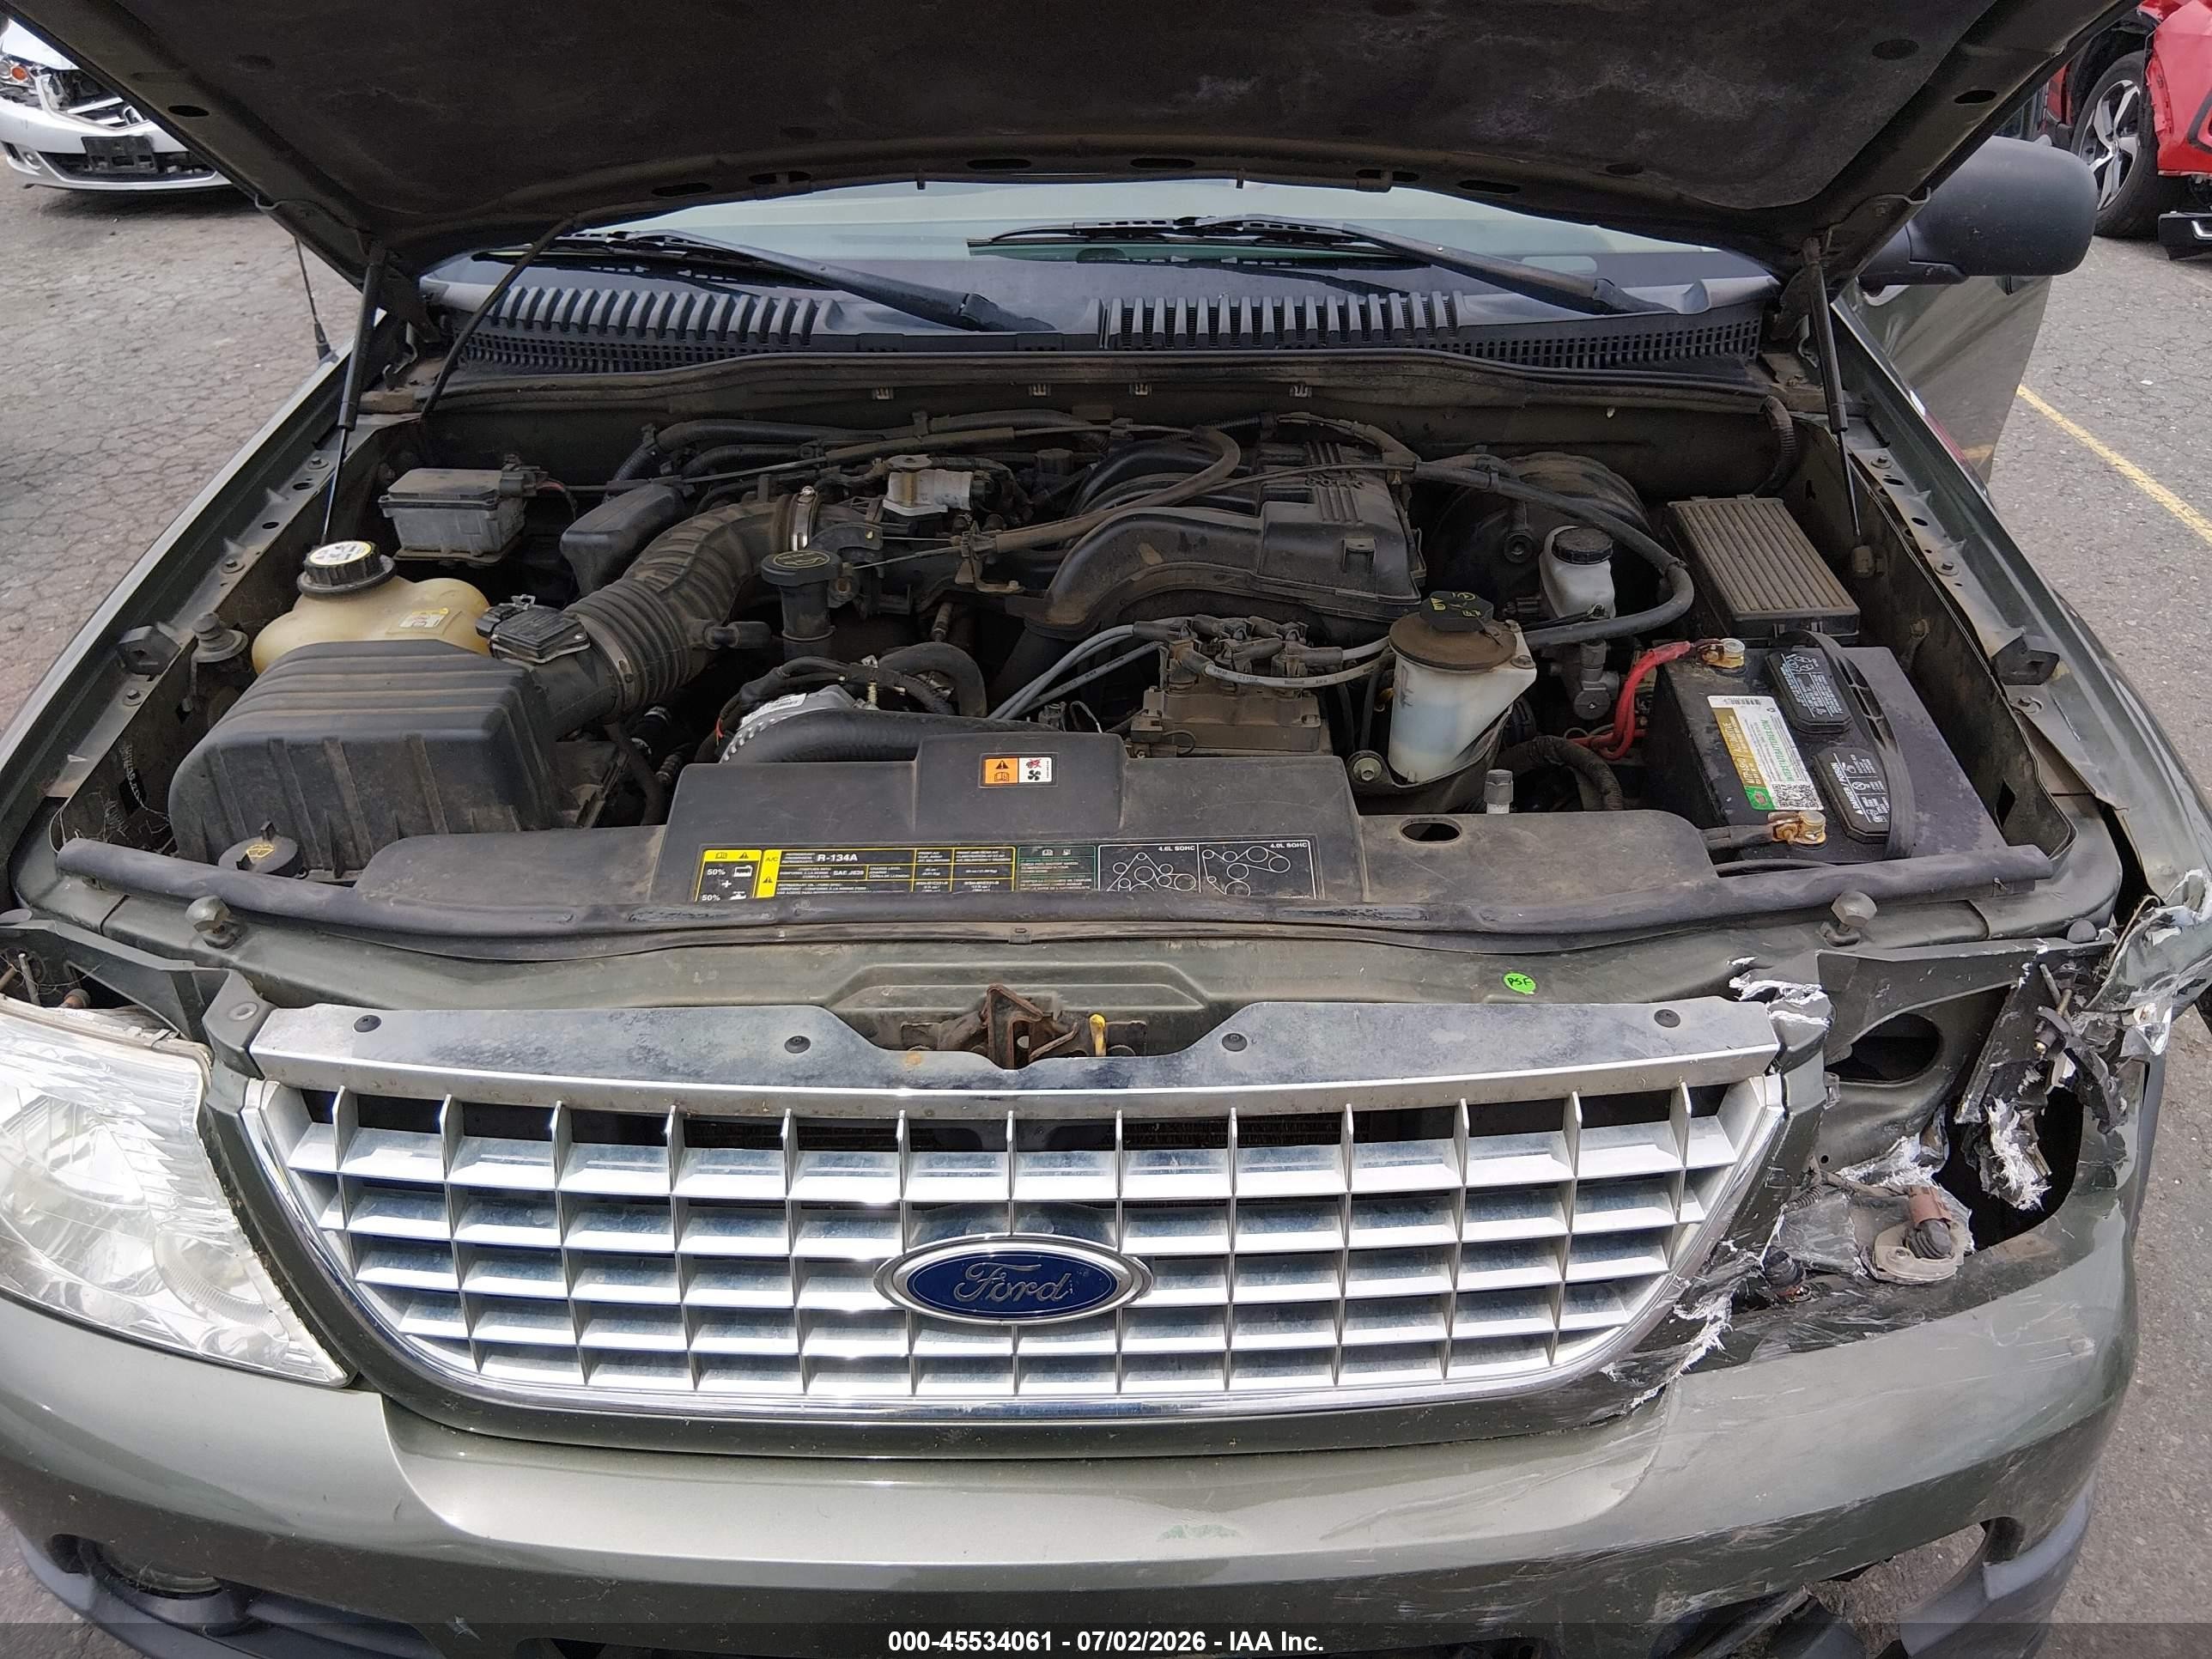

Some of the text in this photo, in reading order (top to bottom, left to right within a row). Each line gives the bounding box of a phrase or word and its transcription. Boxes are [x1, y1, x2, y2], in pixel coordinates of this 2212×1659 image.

[1830, 763, 1847, 781] POISON
[1843, 787, 1861, 809] DANGER
[817, 854, 859, 862] R-134A
[953, 1261, 1073, 1303] Ford
